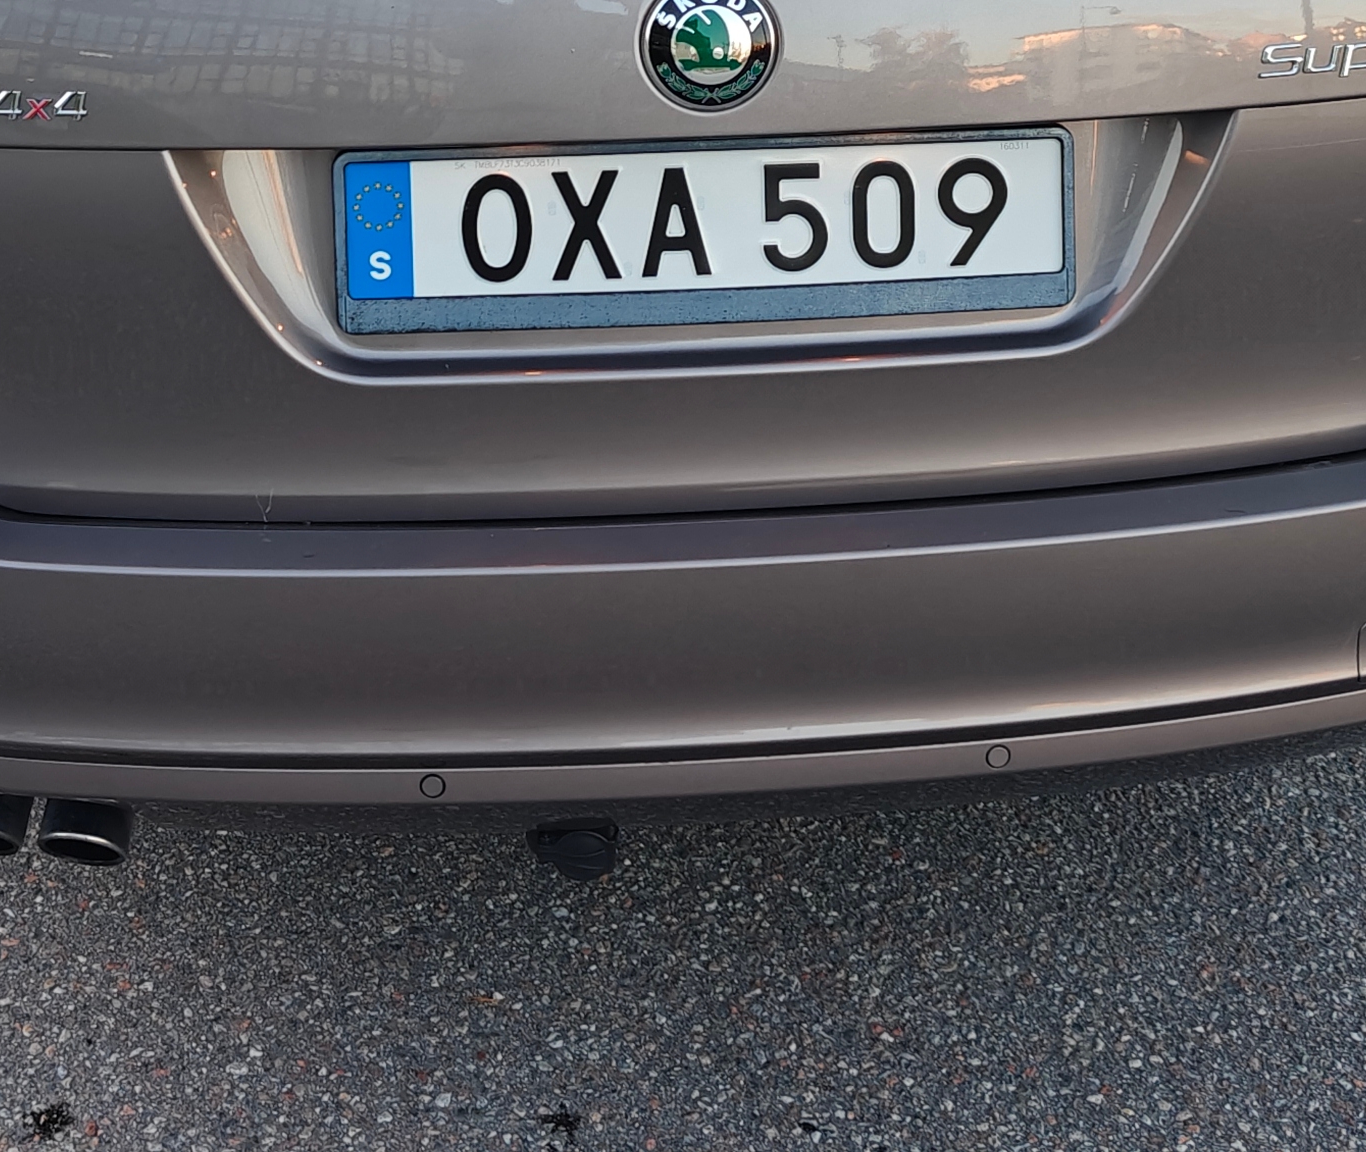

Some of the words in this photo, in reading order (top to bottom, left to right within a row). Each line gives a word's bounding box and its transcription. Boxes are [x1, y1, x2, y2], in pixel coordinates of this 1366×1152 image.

[999, 141, 1030, 151] 160311
[369, 251, 392, 281] S
[461, 166, 713, 282] OXA
[762, 156, 1009, 273] 509
